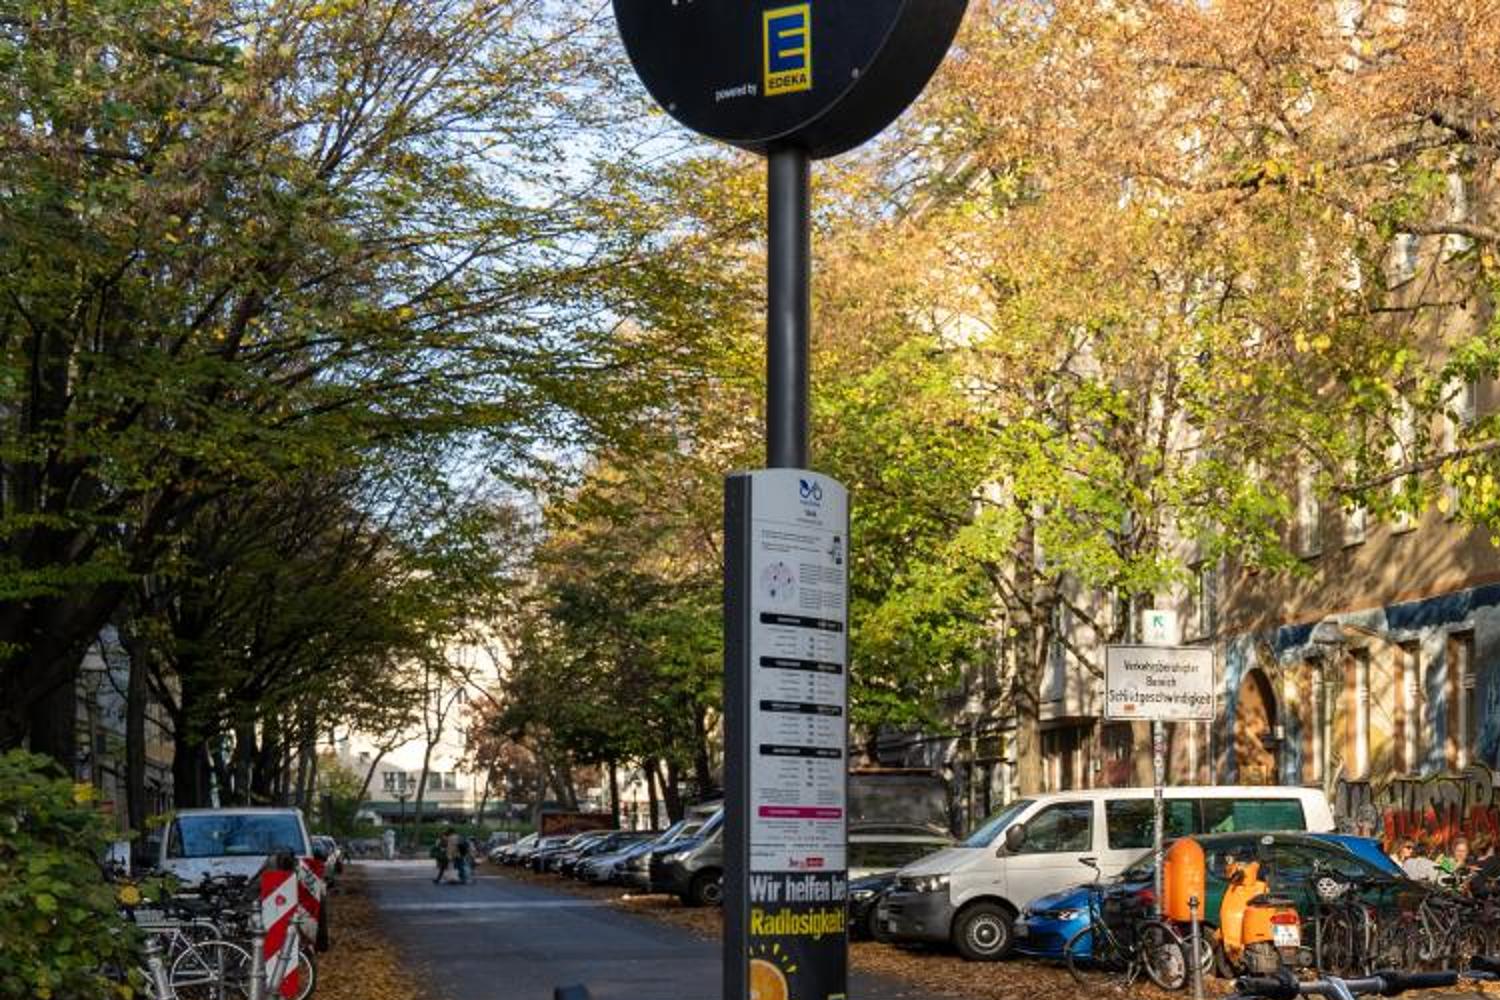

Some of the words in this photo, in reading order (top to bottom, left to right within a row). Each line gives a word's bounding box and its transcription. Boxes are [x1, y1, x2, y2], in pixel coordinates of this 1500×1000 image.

[715, 83, 746, 103] powered
[748, 83, 757, 97] by
[768, 73, 807, 90] EDEKA
[750, 874, 780, 902] Wir
[785, 873, 831, 902] helfen
[751, 906, 846, 940] Radlosigkeit!
